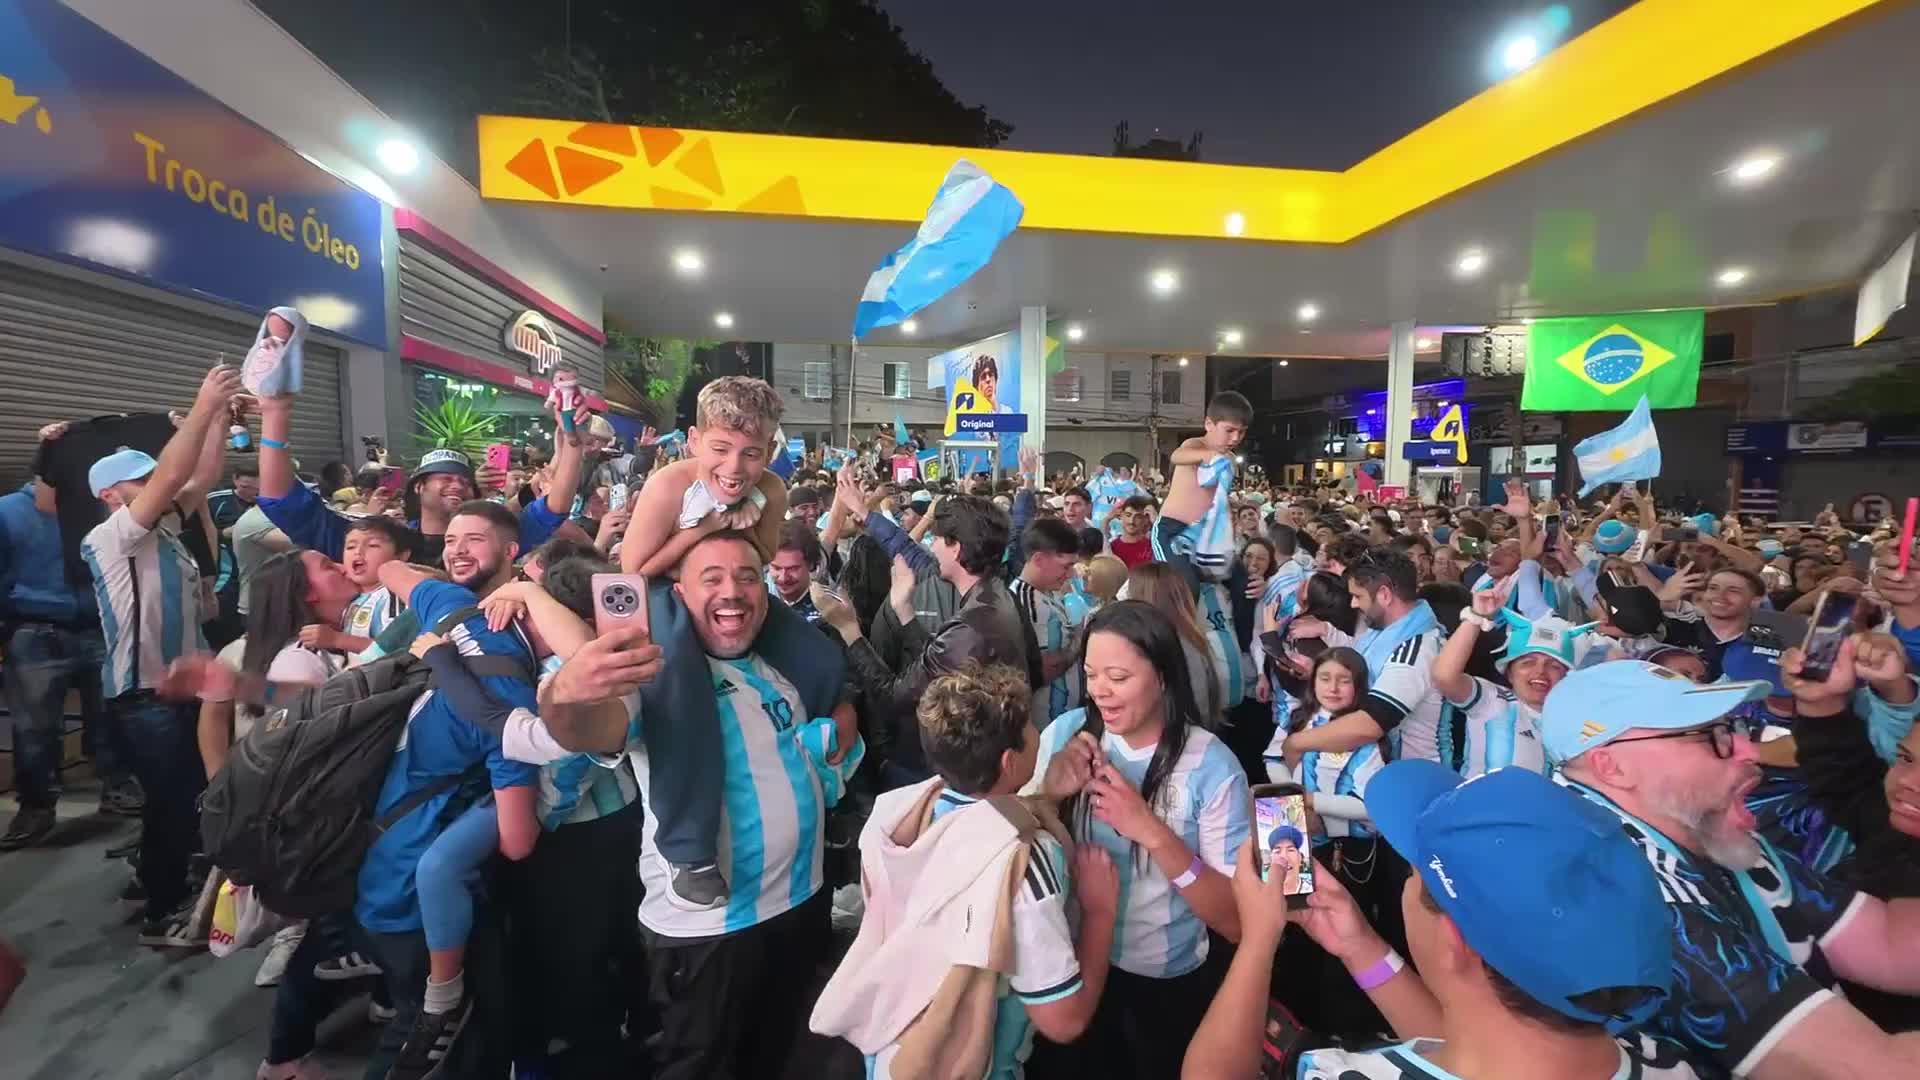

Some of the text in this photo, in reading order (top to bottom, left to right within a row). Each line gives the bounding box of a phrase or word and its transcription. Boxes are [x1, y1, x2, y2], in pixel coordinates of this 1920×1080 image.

[133, 131, 360, 270] Troca de Óleo
[960, 420, 994, 430] Original
[762, 698, 793, 732] 10
